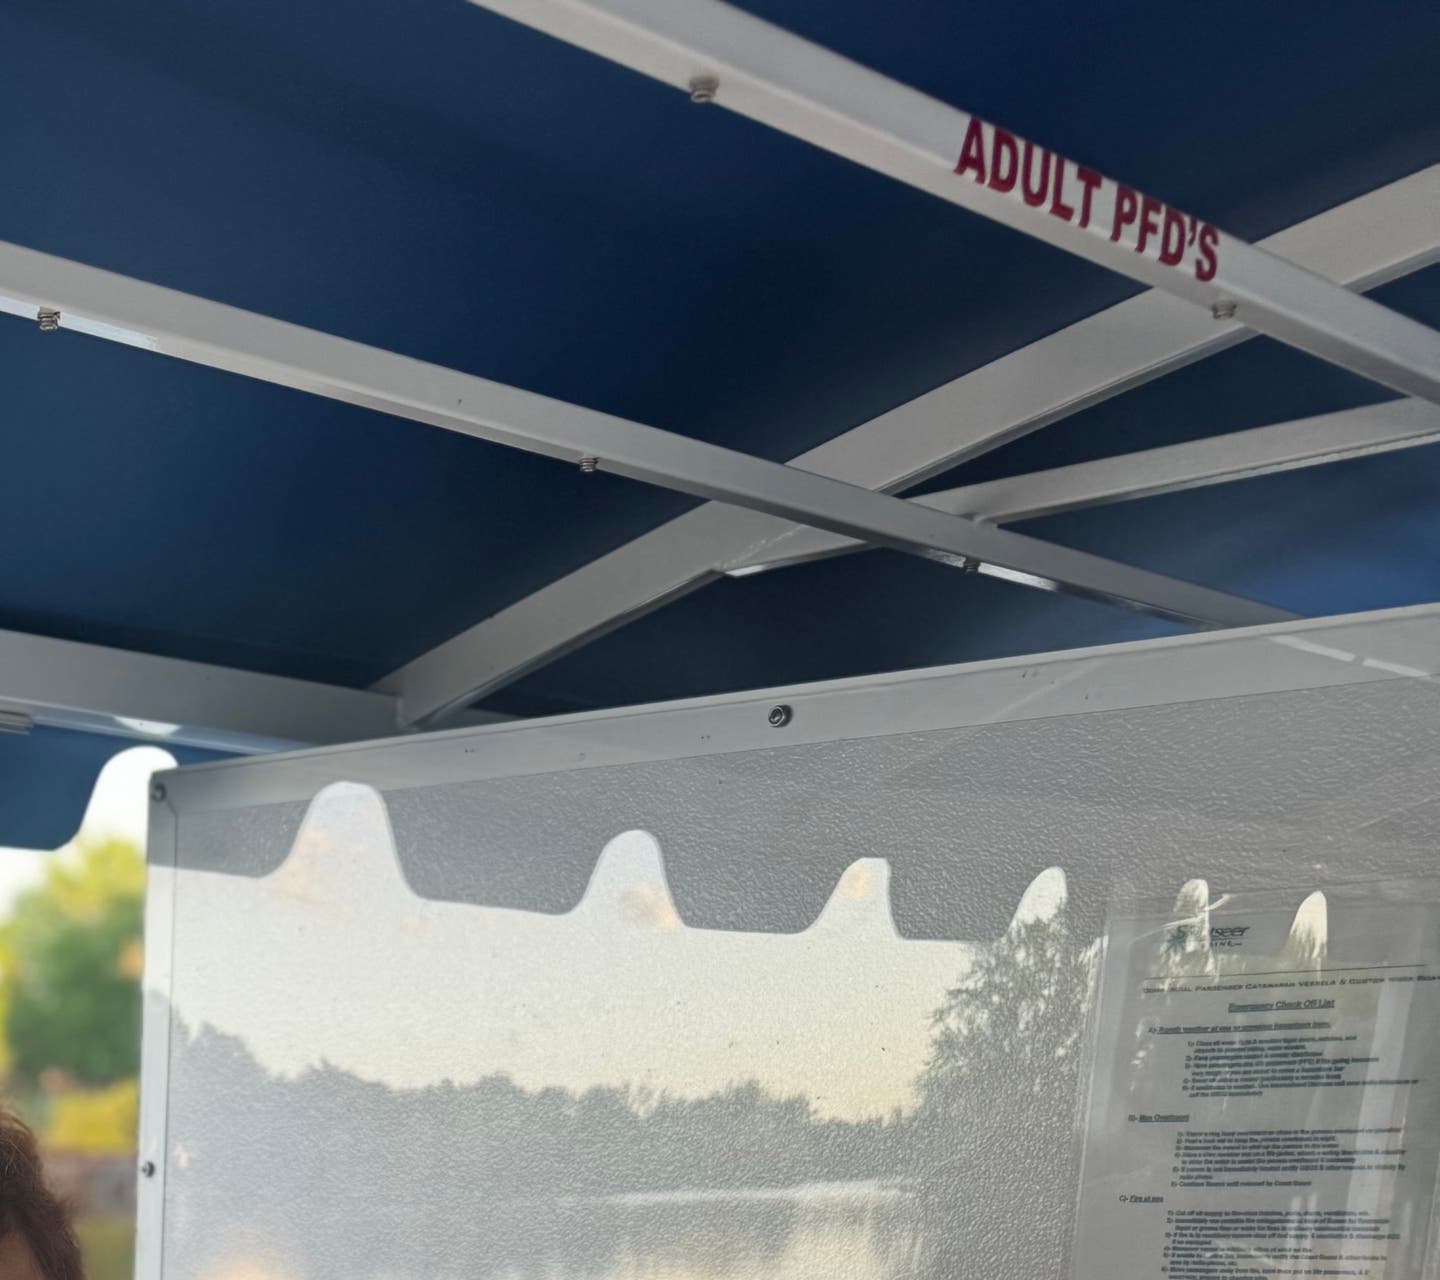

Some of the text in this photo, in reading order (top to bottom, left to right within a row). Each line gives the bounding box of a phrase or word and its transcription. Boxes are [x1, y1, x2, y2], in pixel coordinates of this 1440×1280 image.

[954, 117, 1219, 283] ADULT PFD'S
[1275, 1000, 1302, 1011] Check
[1320, 999, 1335, 1009] List
